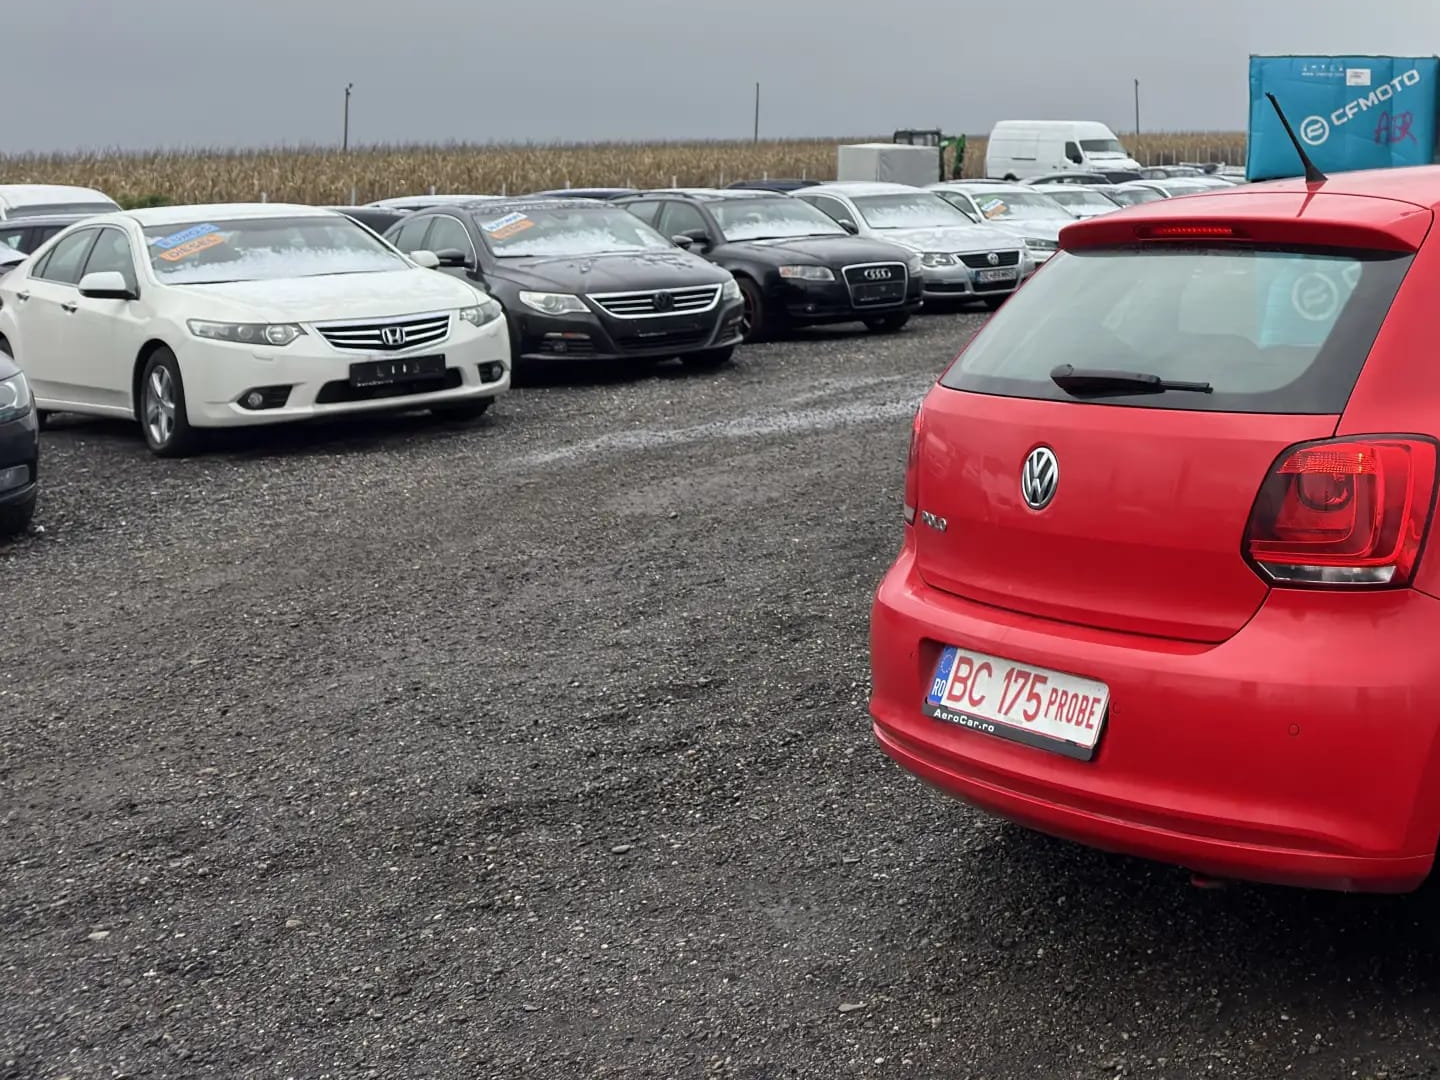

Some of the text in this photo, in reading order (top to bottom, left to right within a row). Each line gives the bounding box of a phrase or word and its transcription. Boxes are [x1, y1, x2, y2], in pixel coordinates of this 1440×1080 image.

[1330, 68, 1420, 126] CFMOTO
[932, 678, 947, 698] RO
[946, 656, 1102, 730] BC 175 PROBE
[933, 708, 995, 733] AeroCar.ro
